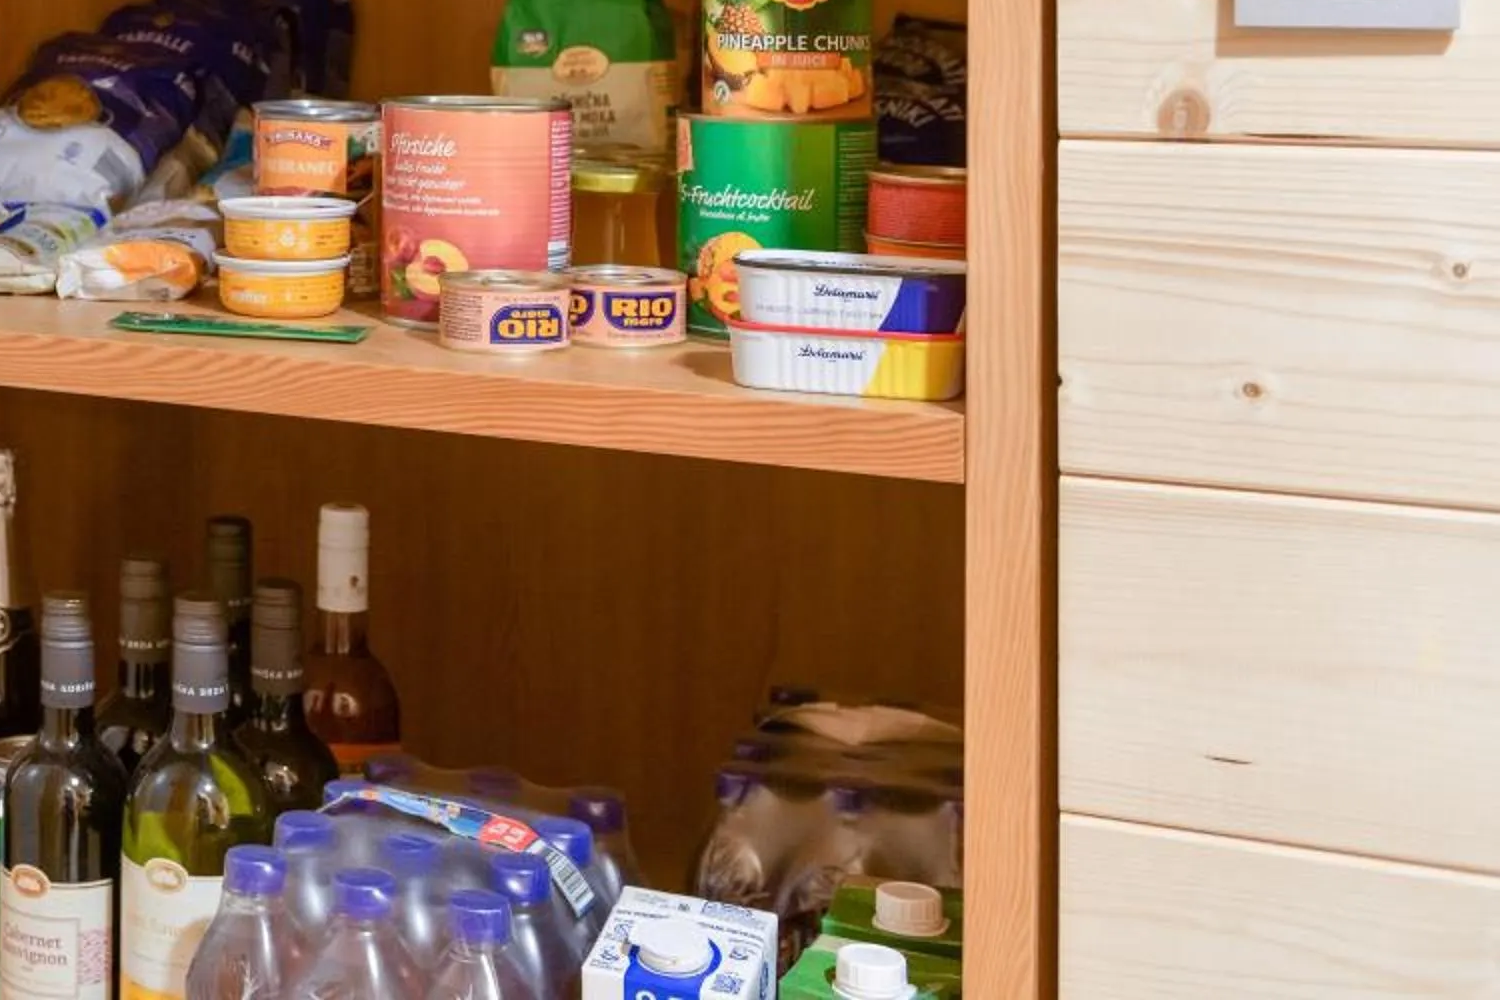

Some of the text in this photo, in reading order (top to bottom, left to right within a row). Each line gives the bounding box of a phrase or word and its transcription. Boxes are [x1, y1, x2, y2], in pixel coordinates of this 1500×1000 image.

[717, 34, 808, 51] PINEAPPLE
[610, 297, 673, 317] RIO
[497, 318, 559, 339] RIO
[623, 317, 664, 327] mare
[3, 921, 62, 949] Cabernet
[2, 938, 68, 965] uvignon
